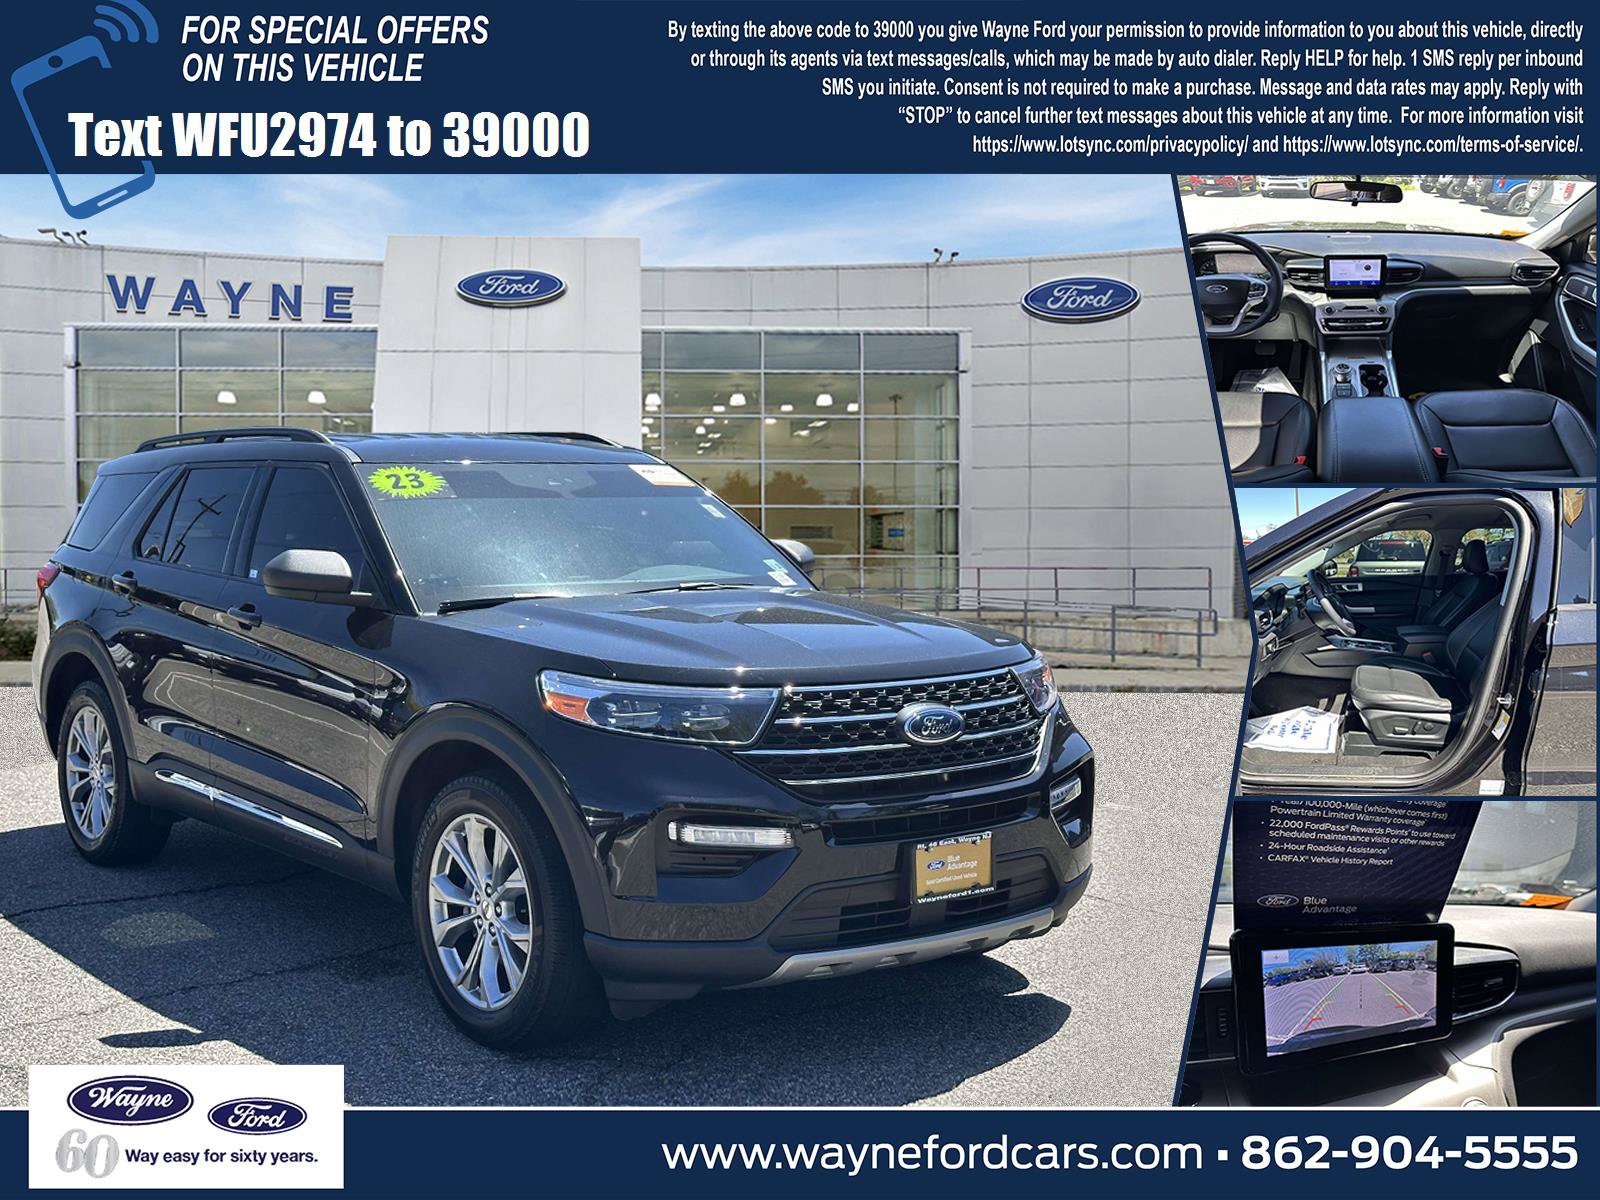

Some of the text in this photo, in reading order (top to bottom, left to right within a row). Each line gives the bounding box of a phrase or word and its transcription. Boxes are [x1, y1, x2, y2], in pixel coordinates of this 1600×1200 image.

[479, 275, 540, 295] Ford
[106, 274, 354, 323] WAYNE
[1046, 284, 1114, 309] Ford
[385, 473, 425, 489] 23
[922, 715, 953, 735] Ford
[1270, 805, 1321, 817] Powertrain
[1323, 809, 1355, 819] Limited
[1356, 812, 1392, 824] Warranty
[1407, 809, 1430, 817] comes
[1269, 829, 1316, 839] scheduled
[1317, 833, 1370, 843] maintenance
[1371, 836, 1390, 844] visits
[1350, 825, 1384, 834] Rewards
[1432, 832, 1456, 840] toward
[1268, 841, 1306, 851] 24-Hour
[1307, 843, 1345, 853] Roadside
[1311, 855, 1339, 864] Vehicle
[1340, 857, 1368, 866] History
[1368, 858, 1393, 866] Report
[1303, 896, 1327, 905] Blue
[1302, 905, 1358, 914] Advantage
